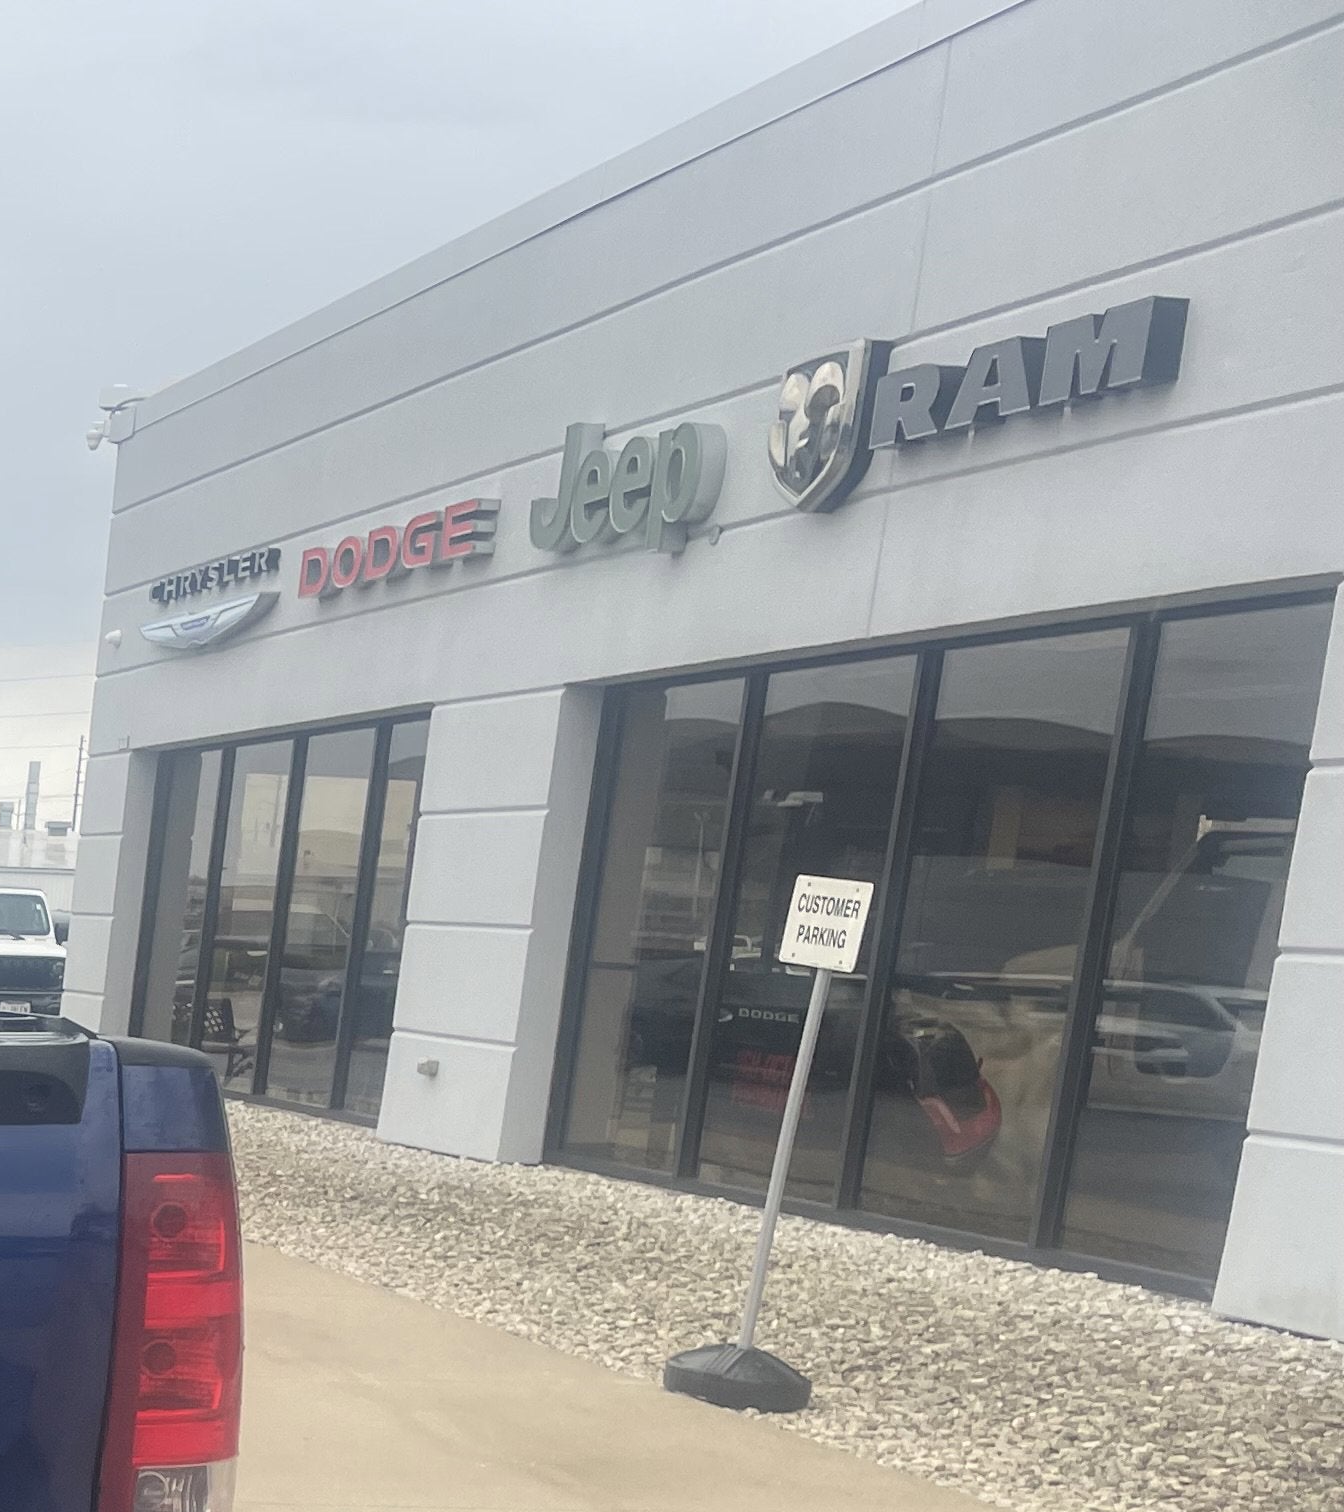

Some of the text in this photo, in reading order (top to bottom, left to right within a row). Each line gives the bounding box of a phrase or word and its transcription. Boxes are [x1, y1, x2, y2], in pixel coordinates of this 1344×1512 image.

[868, 296, 1162, 450] RAM
[529, 421, 708, 553] Jeep
[149, 547, 280, 602] CHRYSLER
[297, 498, 490, 600] DODGE
[797, 893, 861, 920] CUSTOMER
[796, 924, 847, 949] PARKING
[738, 1007, 800, 1024] DODGE
